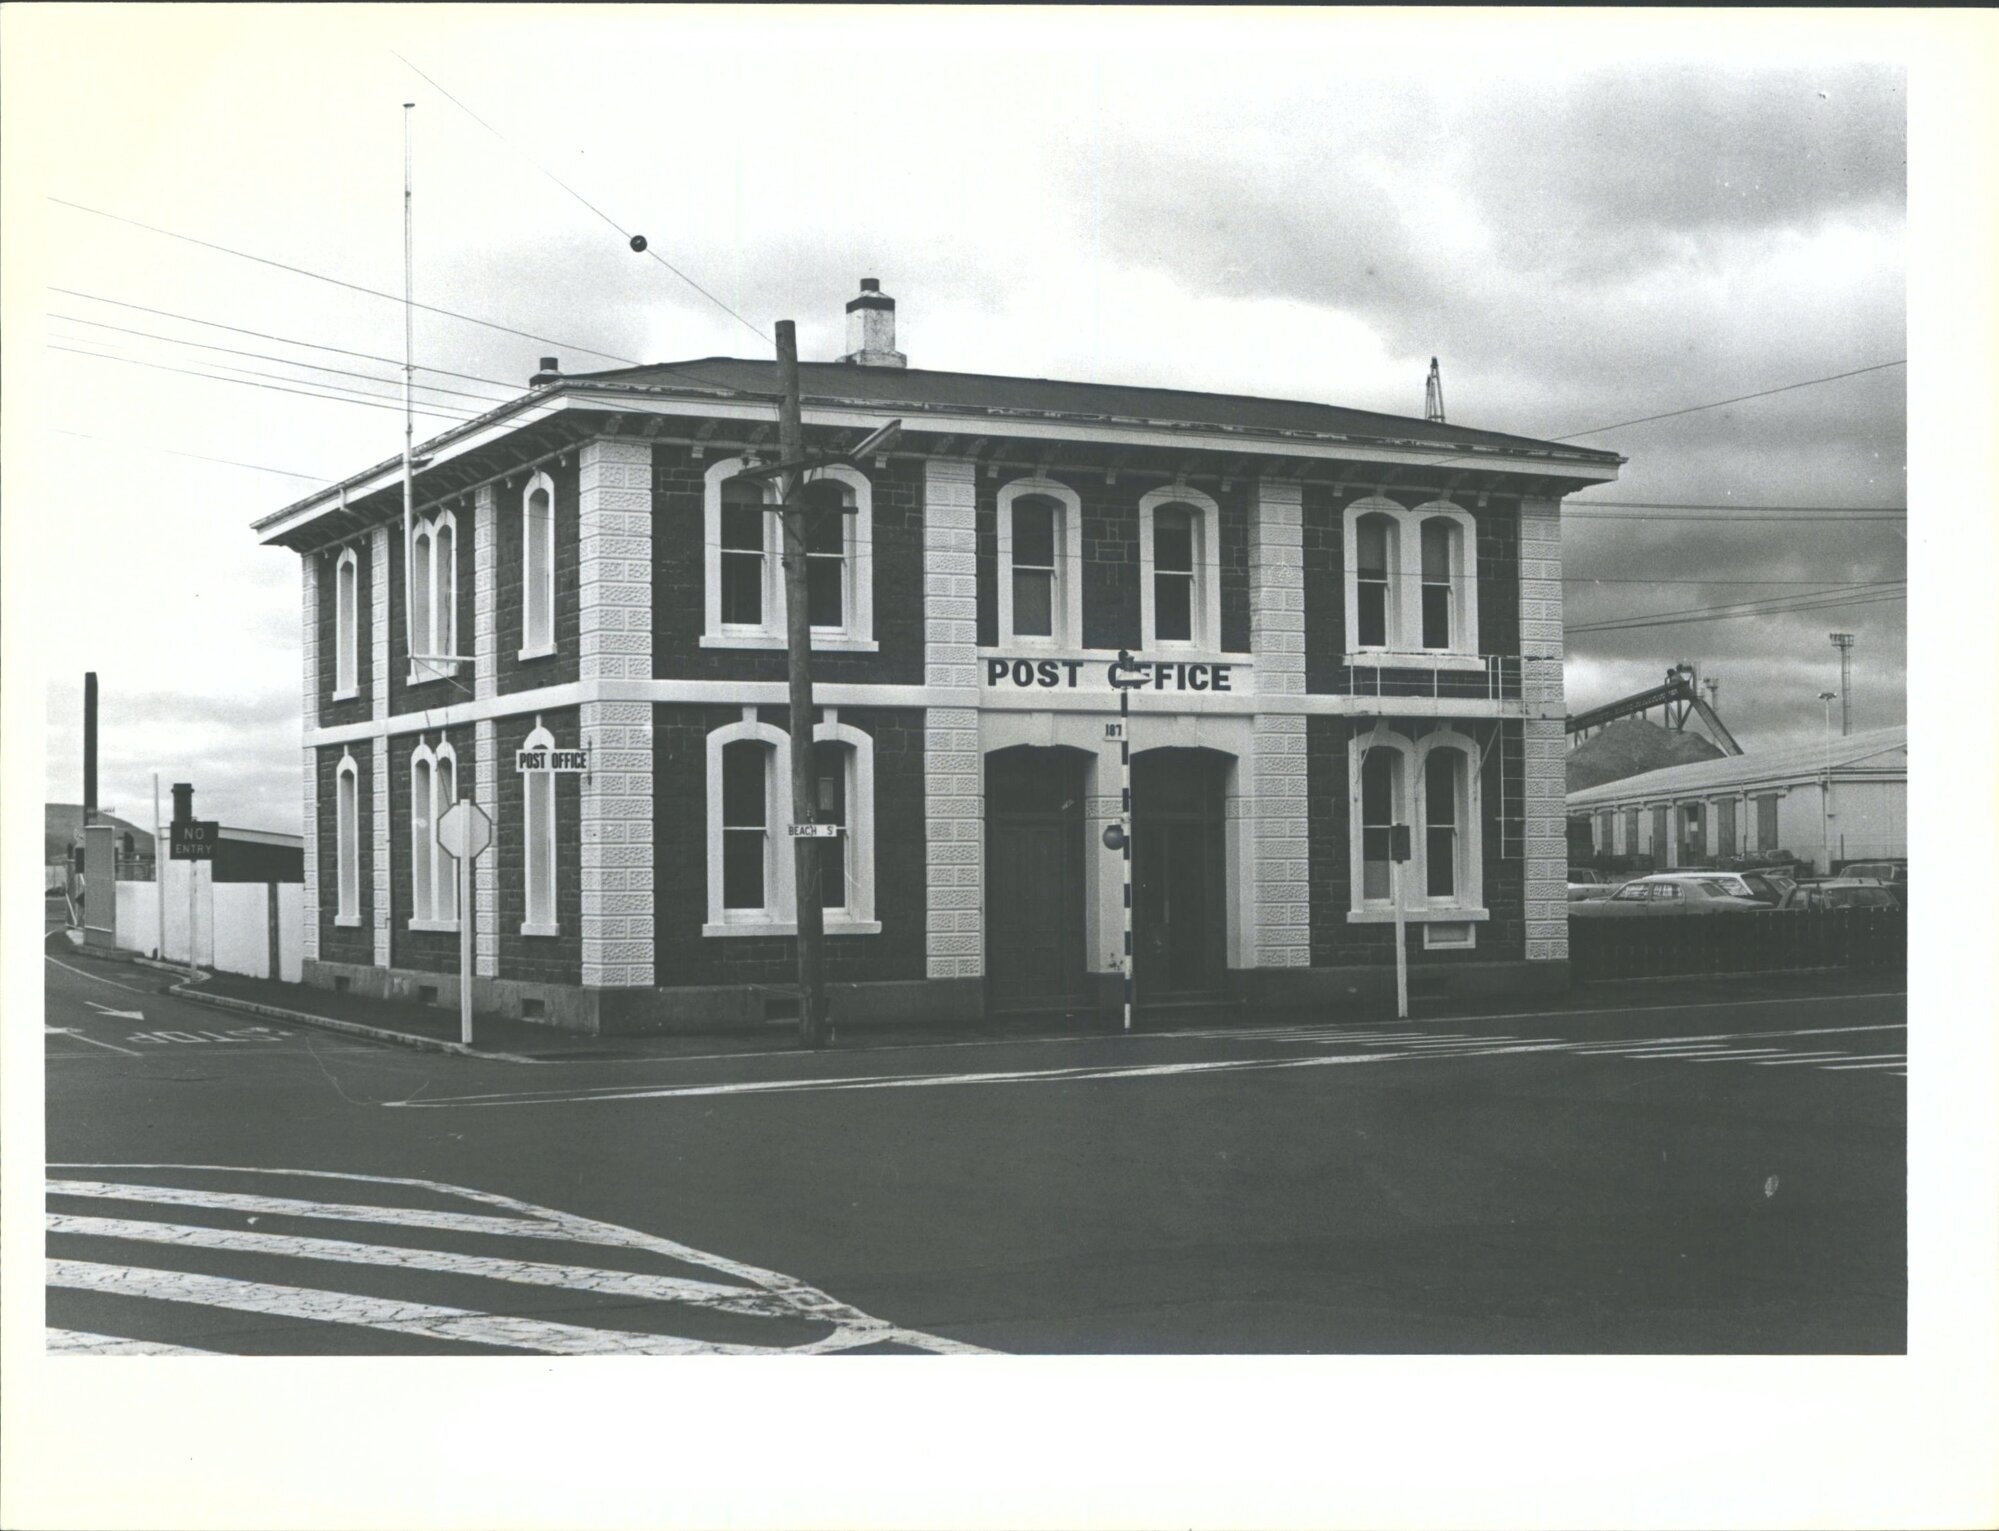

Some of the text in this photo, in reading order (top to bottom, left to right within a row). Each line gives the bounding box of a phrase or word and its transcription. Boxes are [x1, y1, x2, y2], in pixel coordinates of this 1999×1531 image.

[988, 660, 1084, 688] POST
[1105, 723, 1122, 736] 187
[520, 753, 586, 768] POST OFFICE
[184, 827, 204, 840] NO
[789, 826, 817, 835] BEACH
[175, 843, 212, 854] ENTRY
[125, 1027, 293, 1043] STOP
